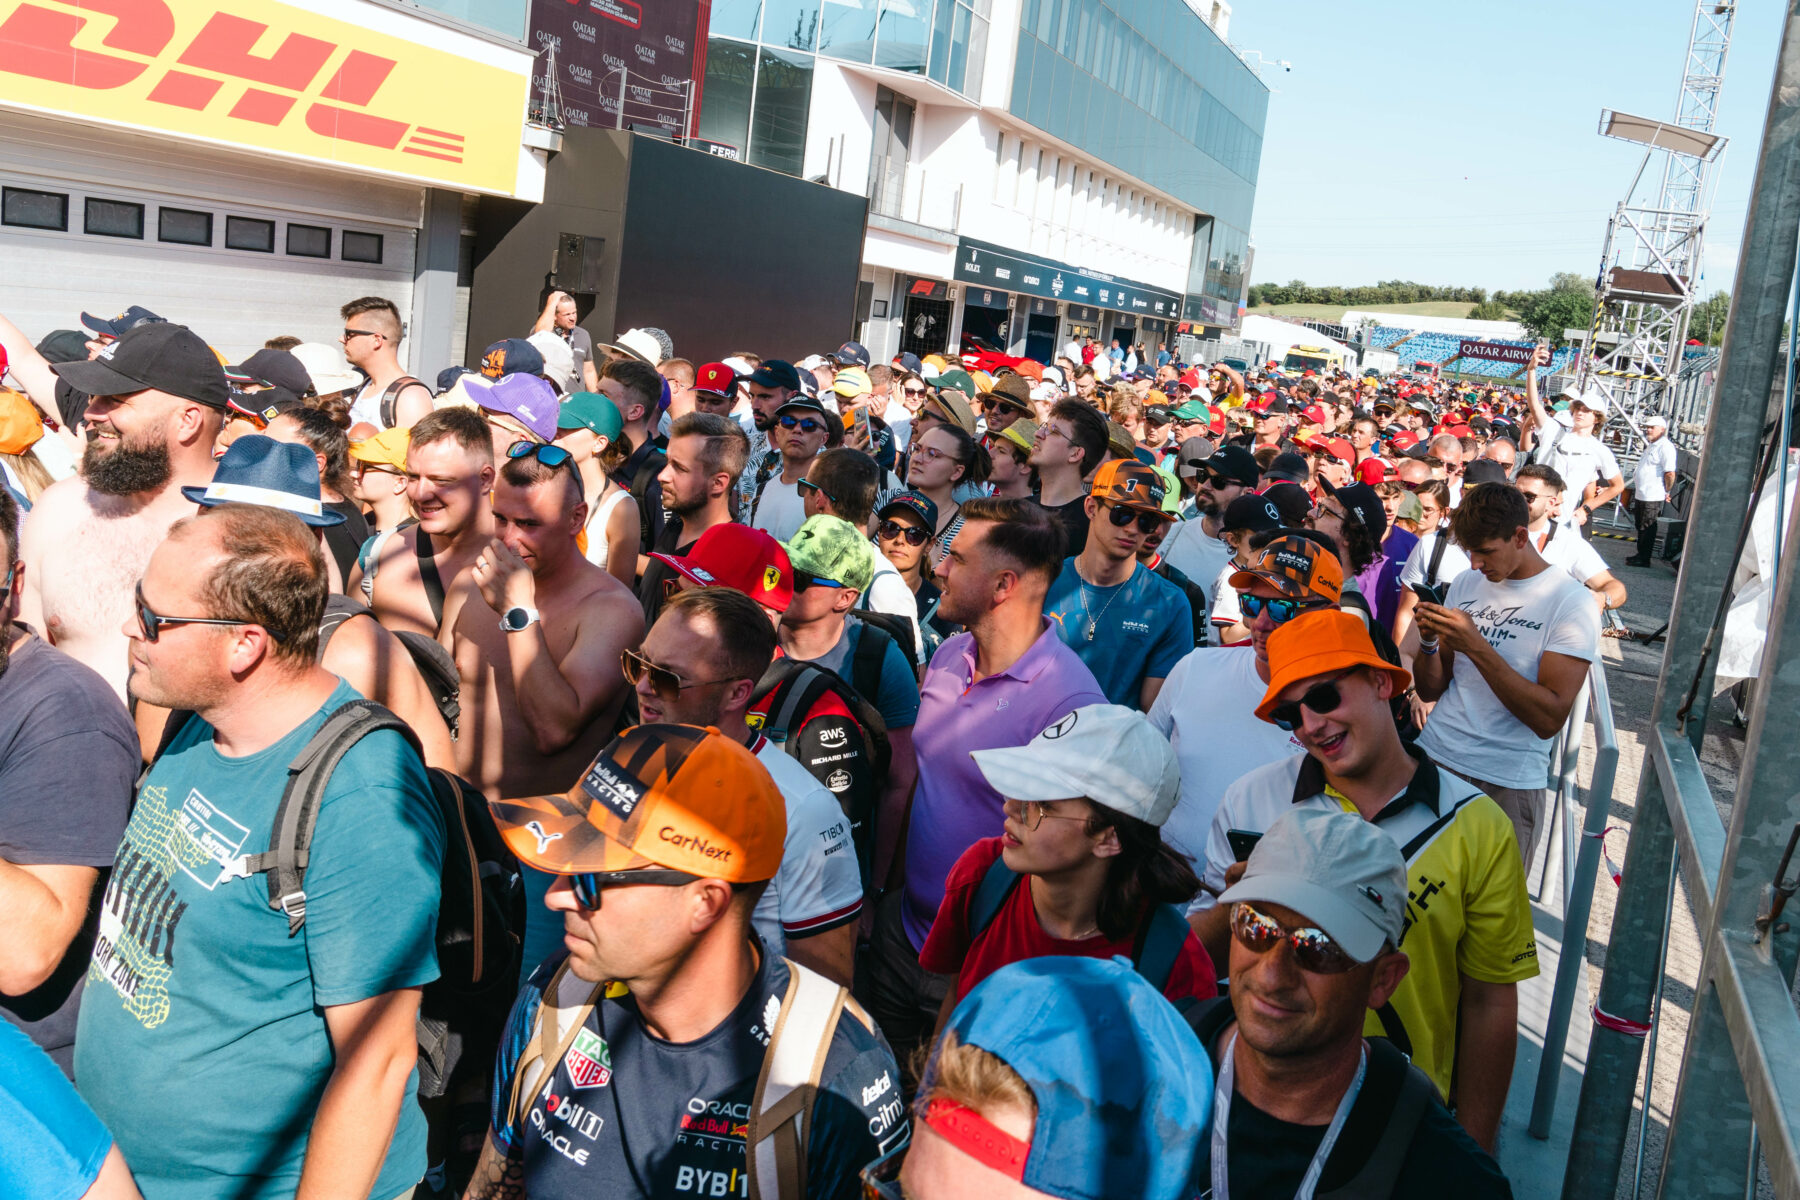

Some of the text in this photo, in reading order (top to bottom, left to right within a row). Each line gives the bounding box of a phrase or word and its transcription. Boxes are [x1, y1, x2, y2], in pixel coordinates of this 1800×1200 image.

[573, 20, 596, 37] QATAR
[536, 30, 562, 47] QATAR
[664, 34, 685, 50] QATAR
[602, 53, 625, 68] QATAR
[634, 44, 656, 60] QATAR
[0, 0, 411, 151] DHL
[568, 63, 593, 80] QATAR
[661, 73, 681, 89] QATAR
[630, 84, 652, 99] QATAR
[564, 106, 589, 122] QATAR
[657, 113, 678, 127] QATAR
[1462, 344, 1533, 361] QATAR AIRW
[1126, 478, 1138, 493] 1
[820, 727, 845, 742] aws
[811, 750, 858, 765] RICHARD MILLE
[586, 774, 632, 812] RACING
[659, 826, 733, 862] CarNext
[95, 931, 144, 998] ORK ZONE
[579, 1033, 612, 1067] TAG
[567, 1052, 609, 1085] HEUER
[687, 1097, 751, 1120] ORACL
[680, 1114, 729, 1134] Red Bull
[530, 1107, 590, 1167] ORACLE
[676, 1134, 747, 1154] RACIN
